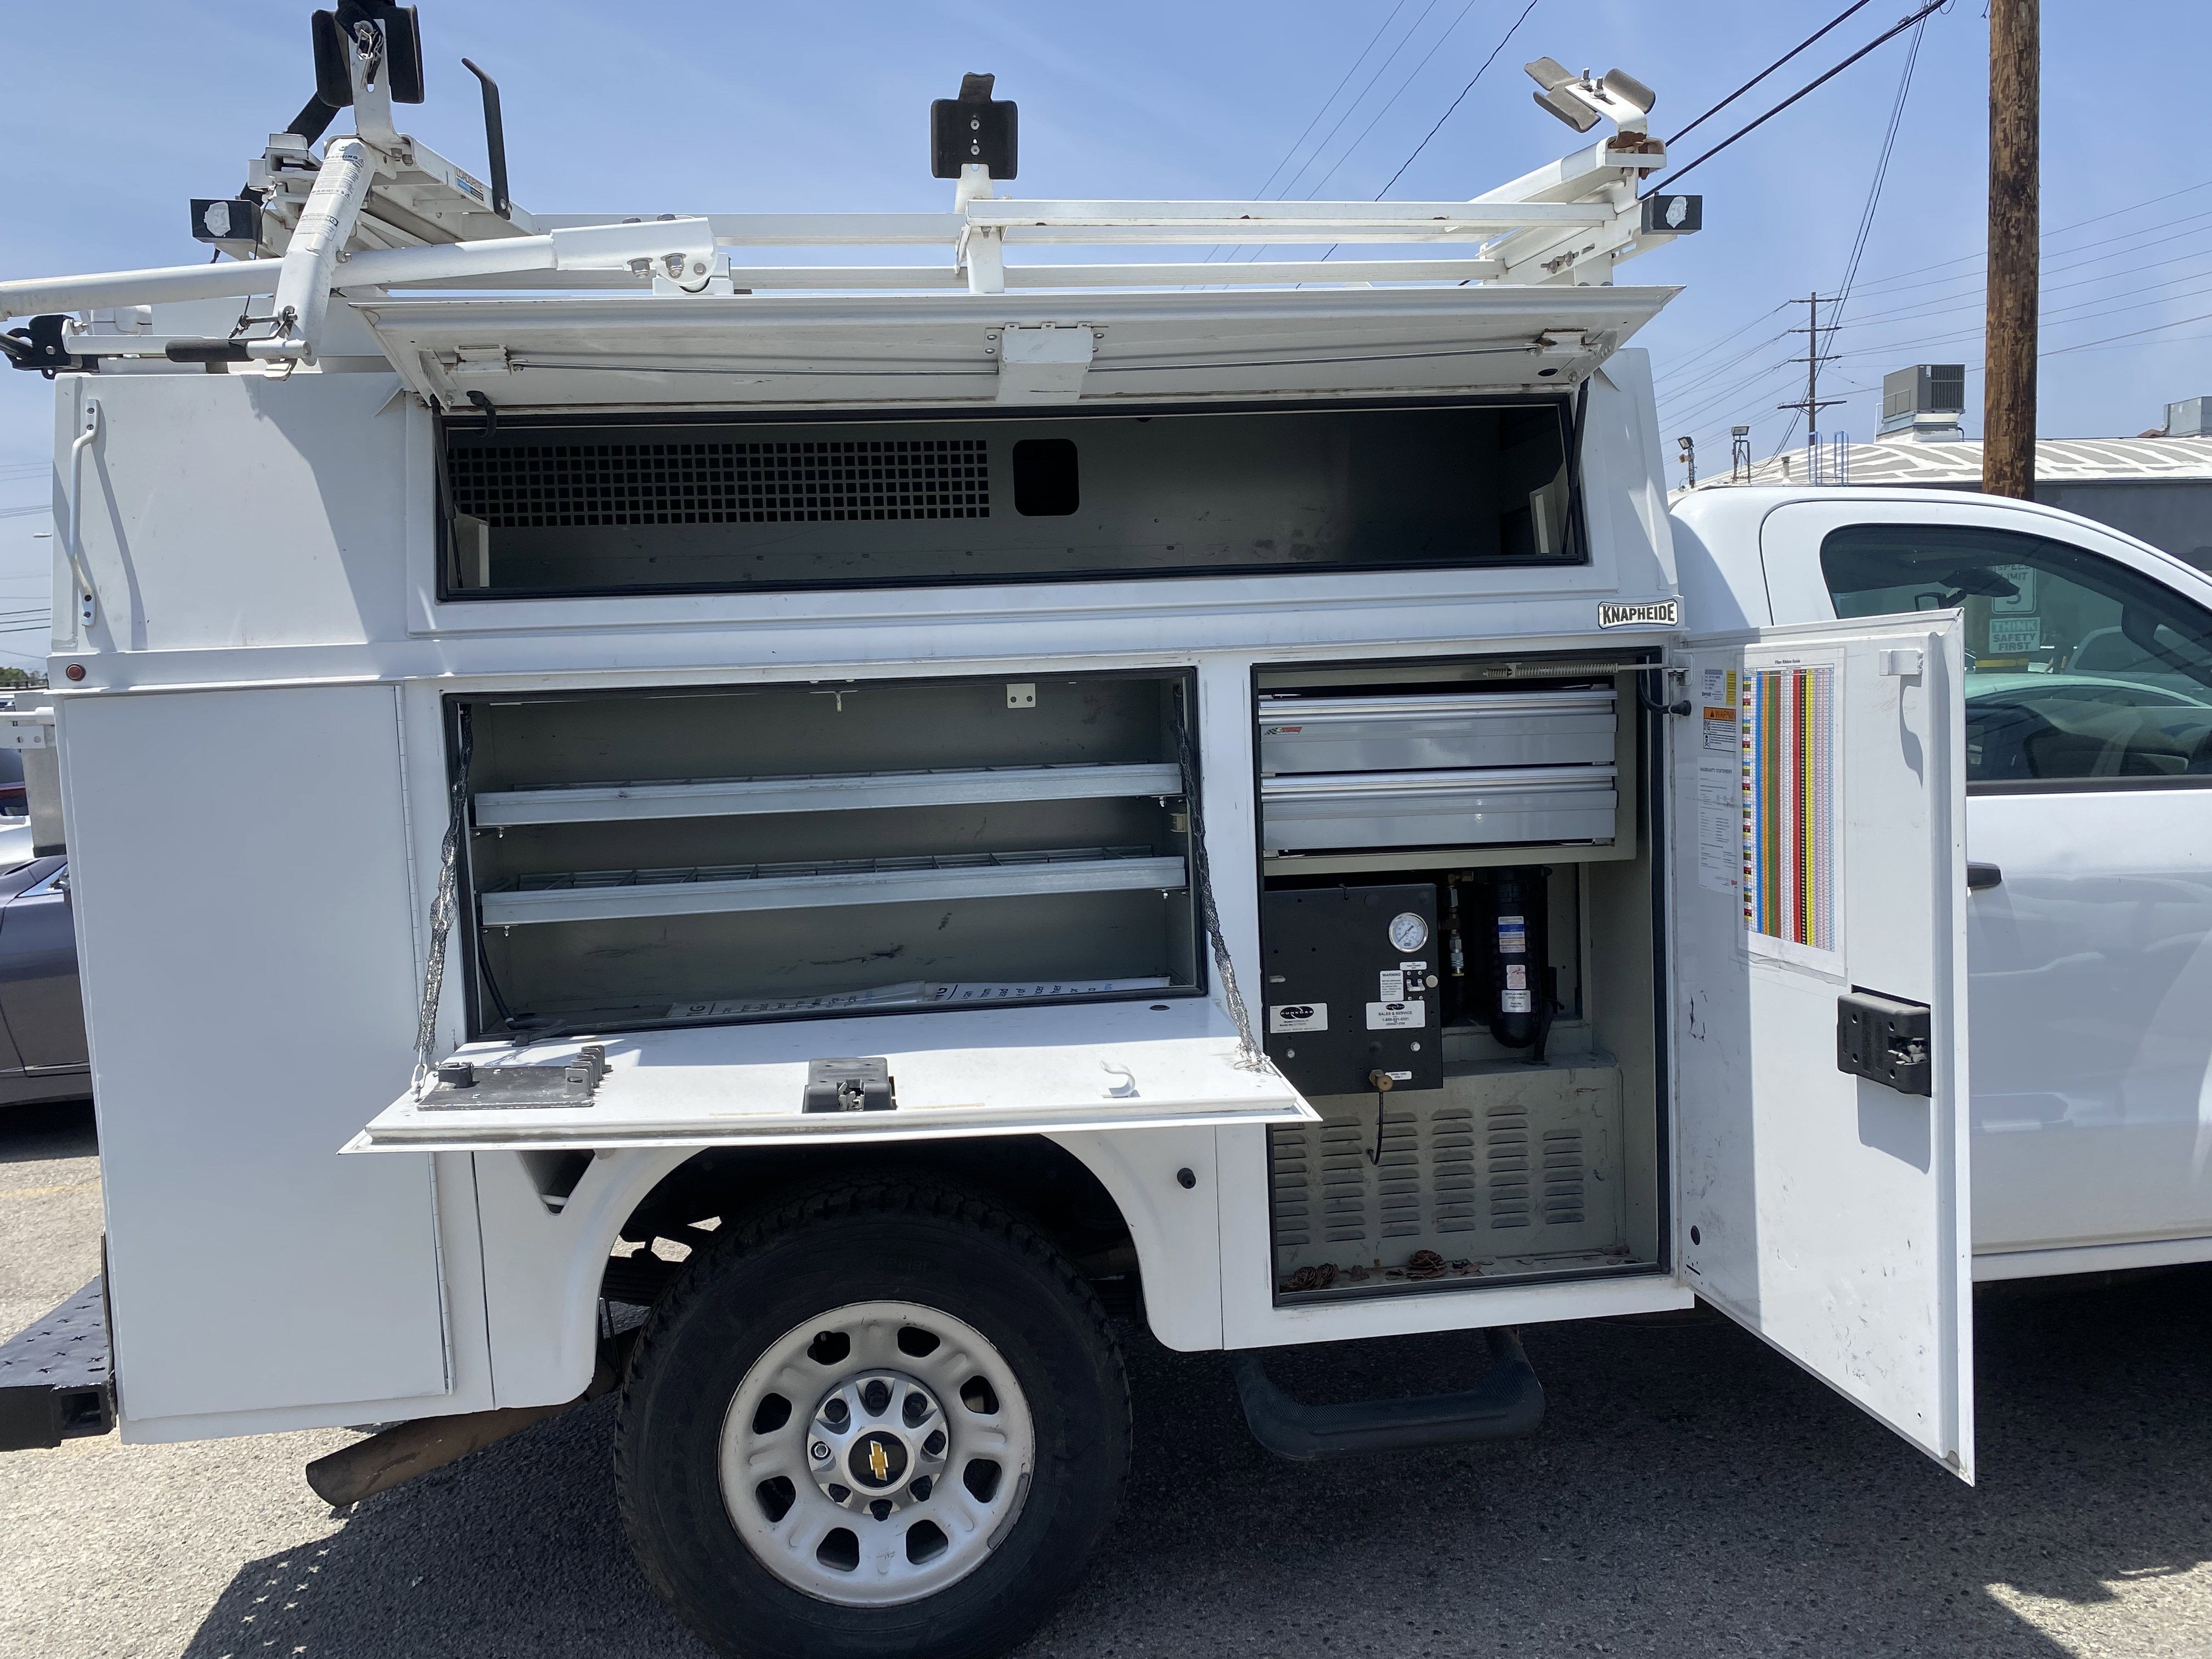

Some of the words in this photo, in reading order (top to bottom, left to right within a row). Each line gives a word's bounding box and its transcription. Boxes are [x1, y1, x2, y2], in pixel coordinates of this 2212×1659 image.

[2001, 572, 2028, 580] IMIT
[1602, 603, 1675, 625] KNAPHEIDE
[1993, 620, 2038, 631] THINK
[1993, 633, 2036, 642] SAFETY
[1999, 642, 2031, 651] FIRST
